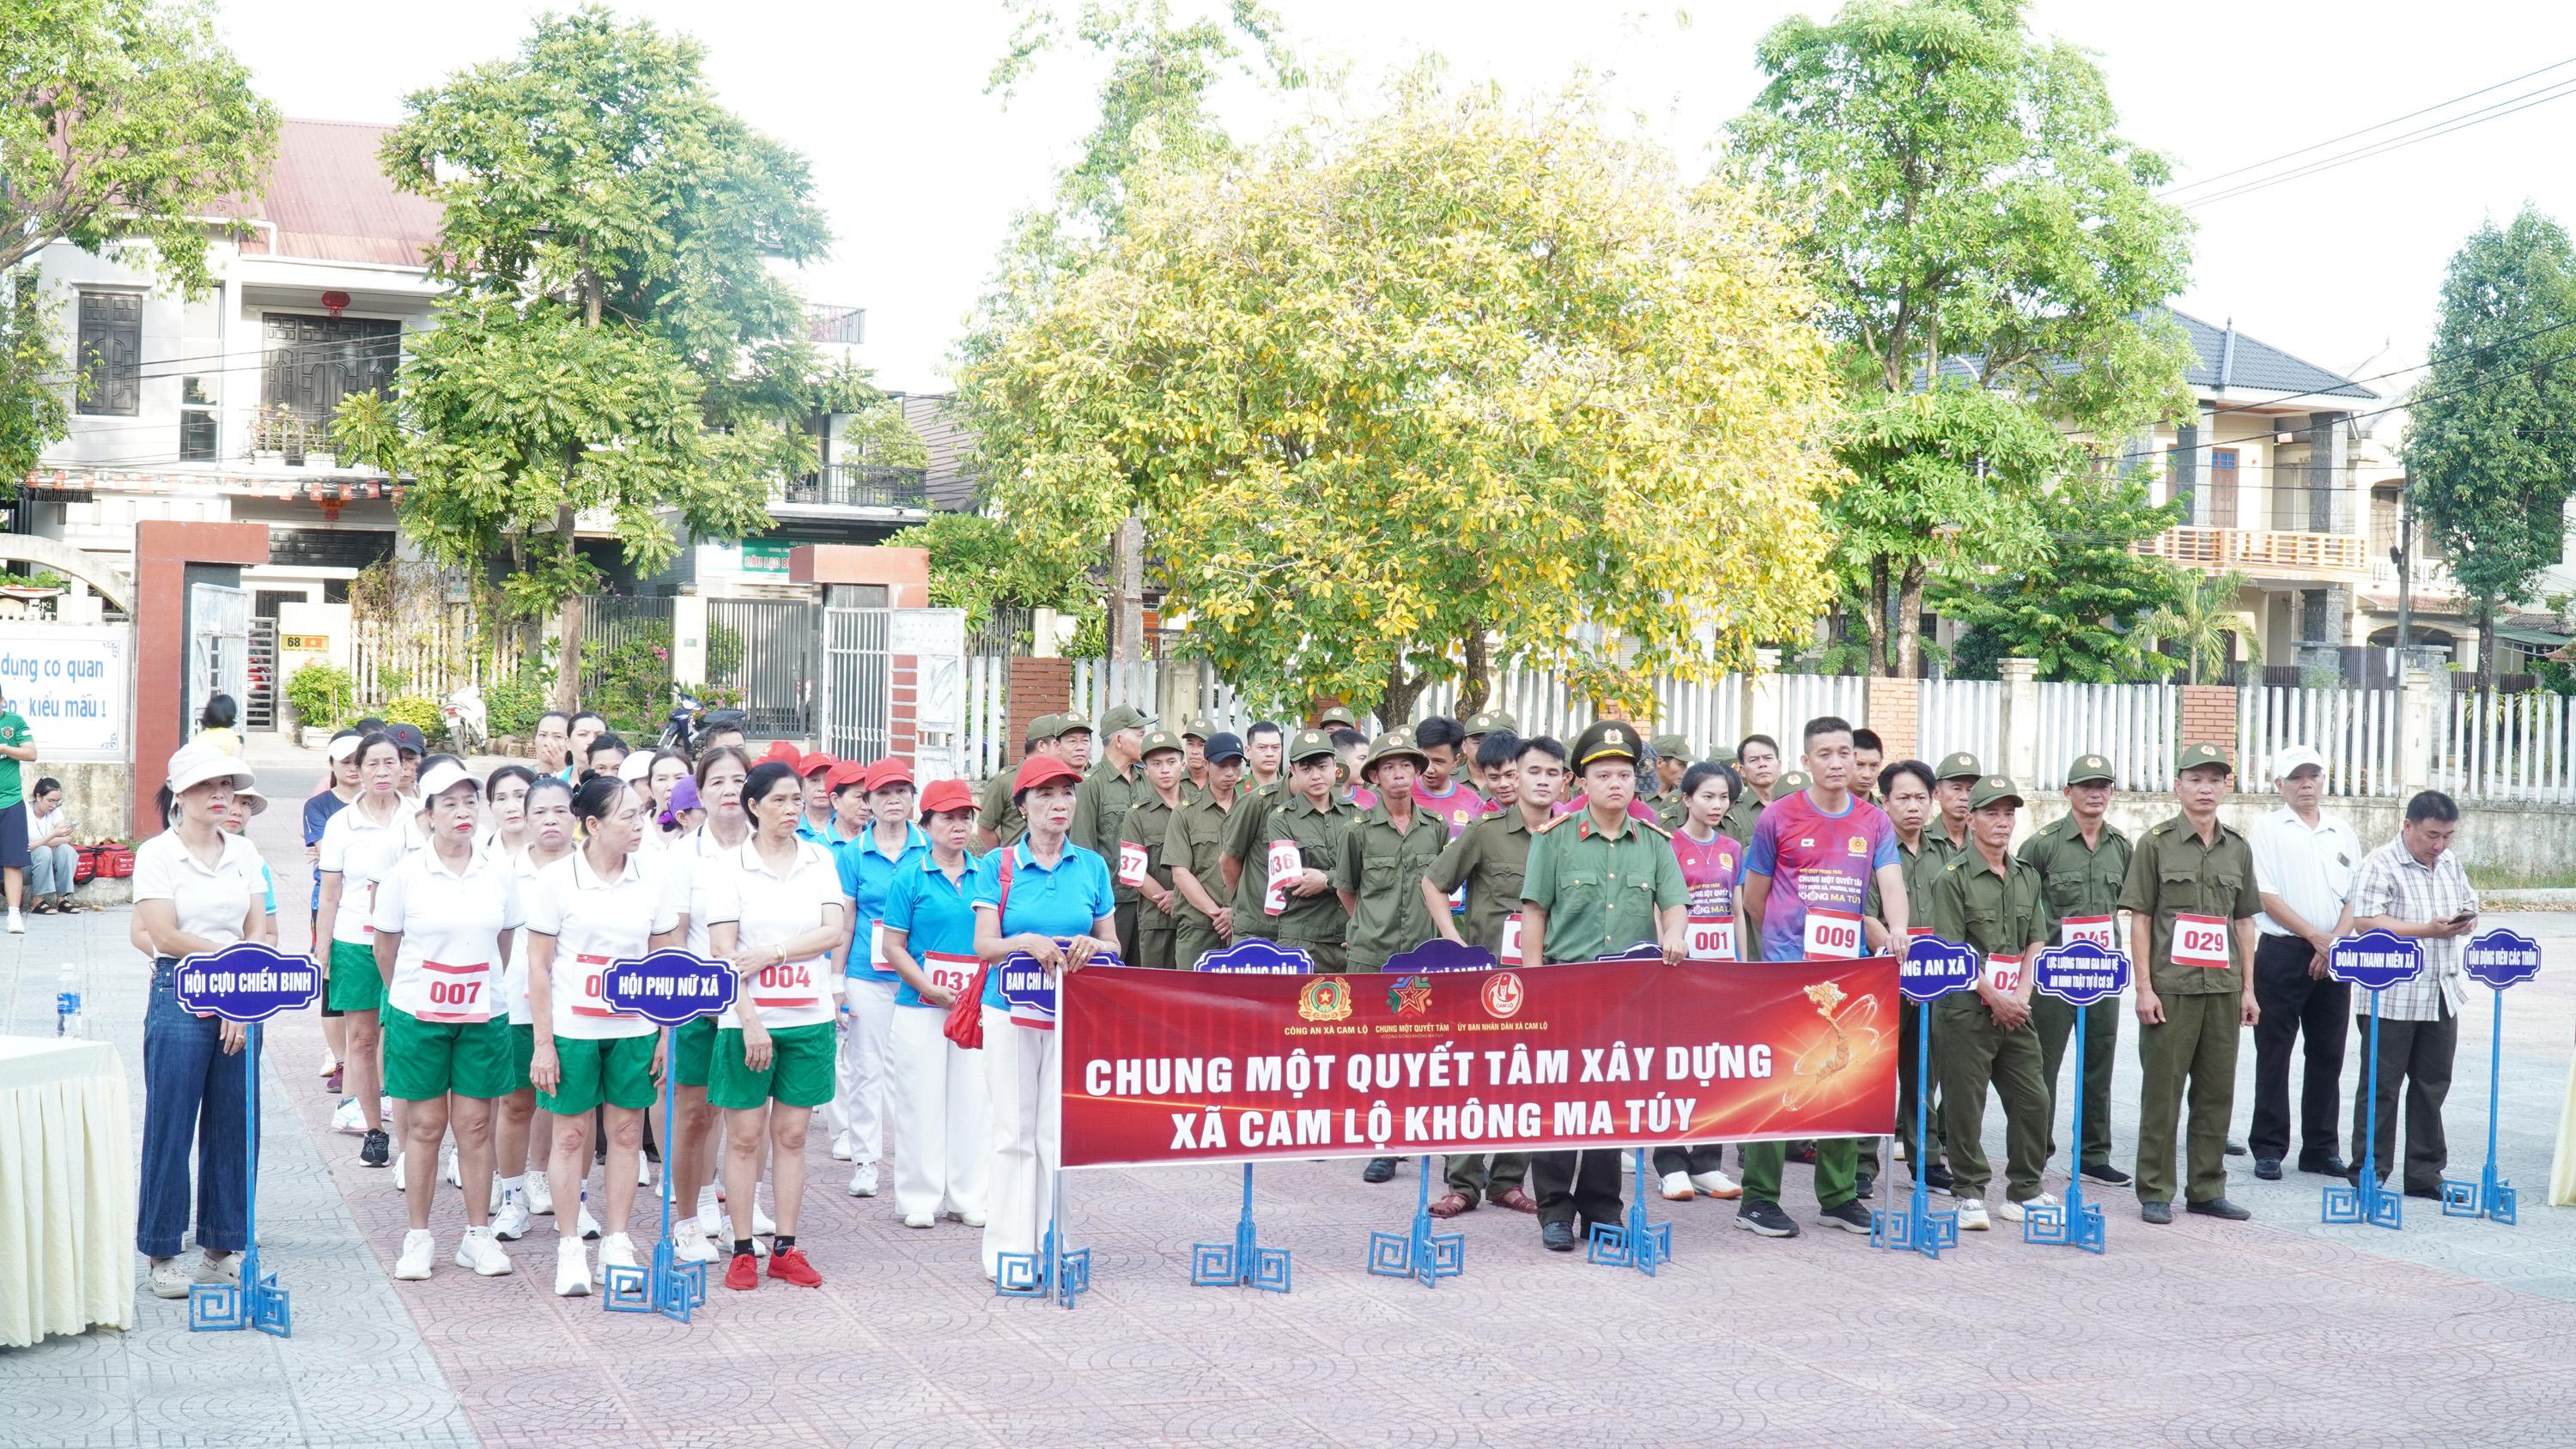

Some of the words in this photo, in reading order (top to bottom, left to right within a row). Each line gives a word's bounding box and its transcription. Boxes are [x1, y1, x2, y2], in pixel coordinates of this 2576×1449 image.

[288, 637, 301, 646] 68
[67, 659, 103, 683] quan
[65, 694, 96, 717] mẫu
[1121, 855, 1142, 872] 37
[1695, 931, 1728, 950] 001
[1815, 925, 1856, 949] 009
[2184, 931, 2224, 952] 029
[1899, 960, 1922, 977] NG
[1924, 959, 1944, 976] AN
[1947, 955, 1966, 975] XÃ
[2336, 949, 2358, 967] ĐOÀN
[2359, 952, 2385, 967] THANH
[2385, 949, 2403, 968] NIÊN
[2404, 950, 2415, 968] XÃ
[2509, 948, 2521, 966] CÁC
[184, 969, 206, 997] HỘI
[210, 971, 235, 997] CỰU
[239, 966, 276, 992] CHIẾN
[280, 972, 312, 991] BINH
[618, 972, 642, 999] HỘI
[646, 975, 674, 1000] PHỤ
[677, 974, 699, 997] NỮ
[700, 973, 719, 997] XÃ
[759, 965, 811, 988] 004
[1005, 973, 1024, 991] BAN
[1026, 966, 1042, 991] CHỈ
[1994, 971, 2020, 990] 02
[429, 981, 482, 1005] 007
[1284, 1026, 1308, 1035] CÔNG
[1336, 1026, 1355, 1034] CAM
[1357, 1024, 1368, 1035] LỘ
[1375, 1024, 1398, 1034] CHUNG
[1399, 1022, 1413, 1034] MỘT
[1414, 1022, 1434, 1033] QUYẾT
[1436, 1023, 1449, 1032] TÂM
[1481, 1022, 1498, 1030] NHÂN
[1500, 1022, 1513, 1030] DÂN
[1085, 1057, 1233, 1096] CHUNG
[1245, 1048, 1335, 1099] MỘT
[1346, 1040, 1475, 1094] QUYẾT
[1485, 1043, 1569, 1086] TÂM
[1579, 1040, 1656, 1083] XÂY
[1666, 1042, 1772, 1088] DỰNG
[1170, 1105, 1228, 1150] XÃ
[1238, 1109, 1332, 1148] CAM
[1344, 1100, 1393, 1150] LỘ
[1404, 1097, 1541, 1143] KHÔNG
[1553, 1100, 1614, 1137] MA
[1625, 1092, 1697, 1133] TÚY
